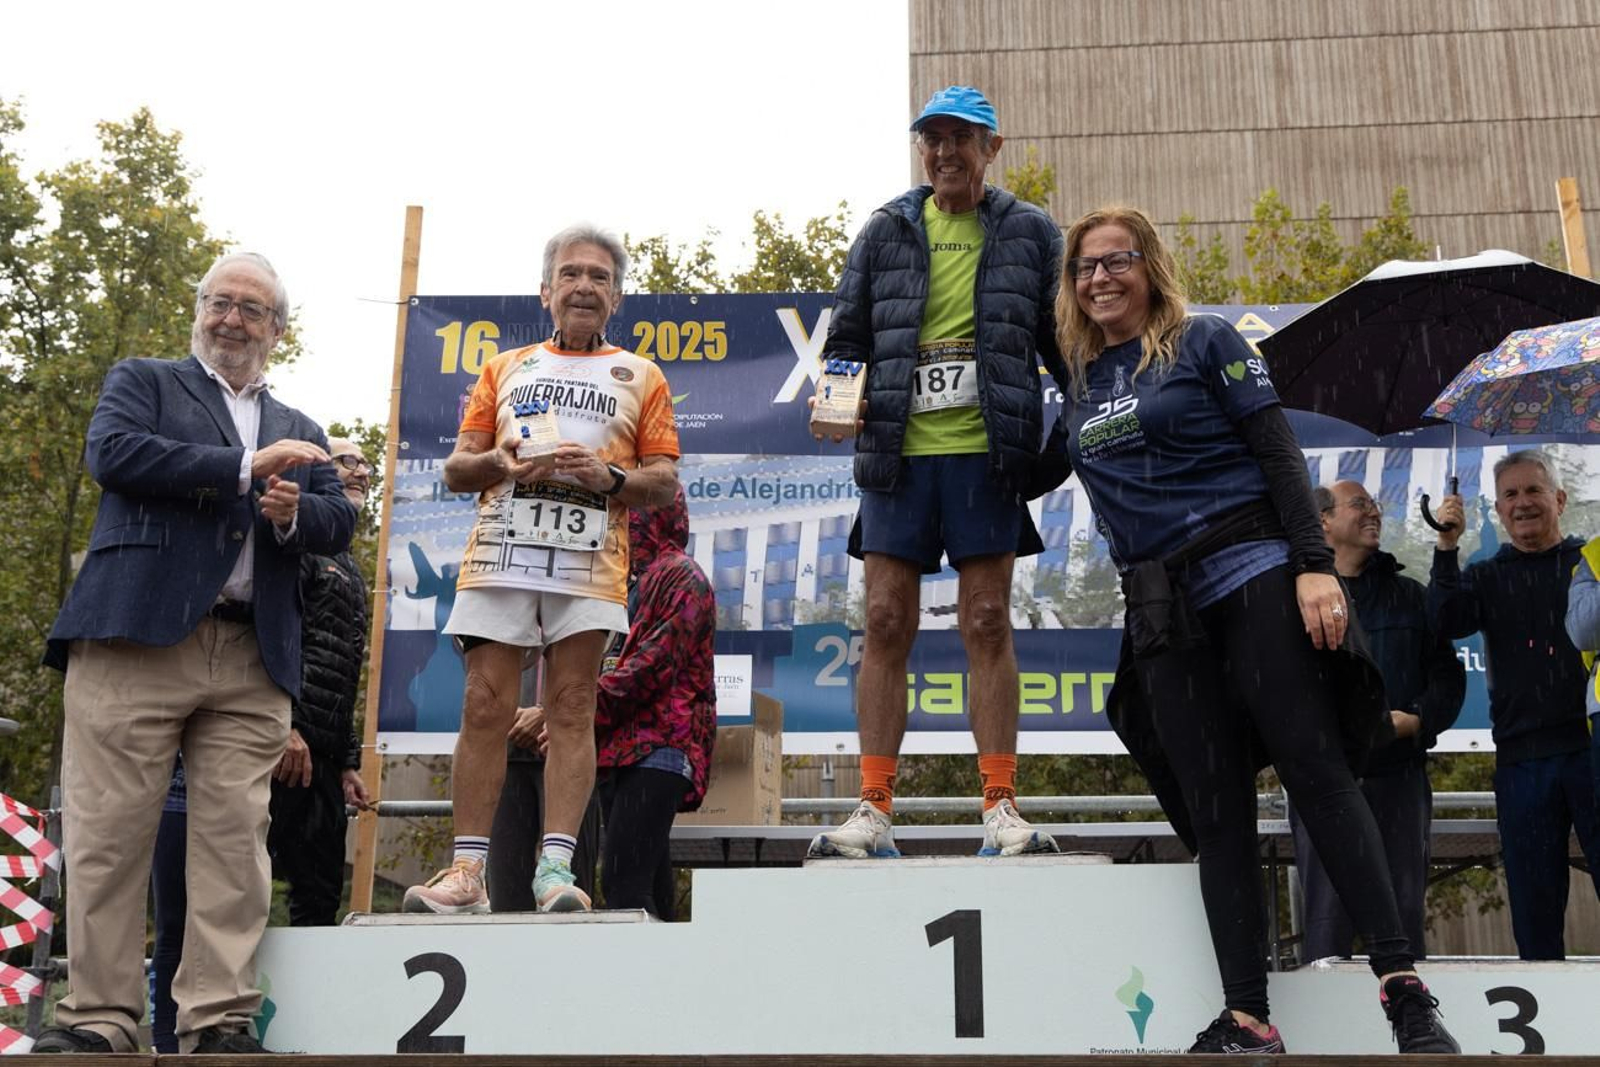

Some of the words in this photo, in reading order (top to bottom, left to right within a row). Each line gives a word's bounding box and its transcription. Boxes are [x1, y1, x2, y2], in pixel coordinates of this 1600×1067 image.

[435, 320, 500, 374] 16
[633, 320, 727, 362] 2025
[825, 358, 863, 377] XXV
[914, 365, 965, 396] 187
[513, 399, 549, 418] XXV
[554, 407, 607, 424] disfruta
[1080, 394, 1139, 431] 25
[1079, 412, 1138, 440] CARRERA
[1079, 420, 1140, 450] POPULAR
[688, 475, 720, 498] de
[730, 476, 866, 504] Alejandría
[529, 502, 587, 535] 113
[925, 909, 985, 1038] 1
[396, 952, 467, 1054] 2
[1484, 986, 1546, 1055] 3
